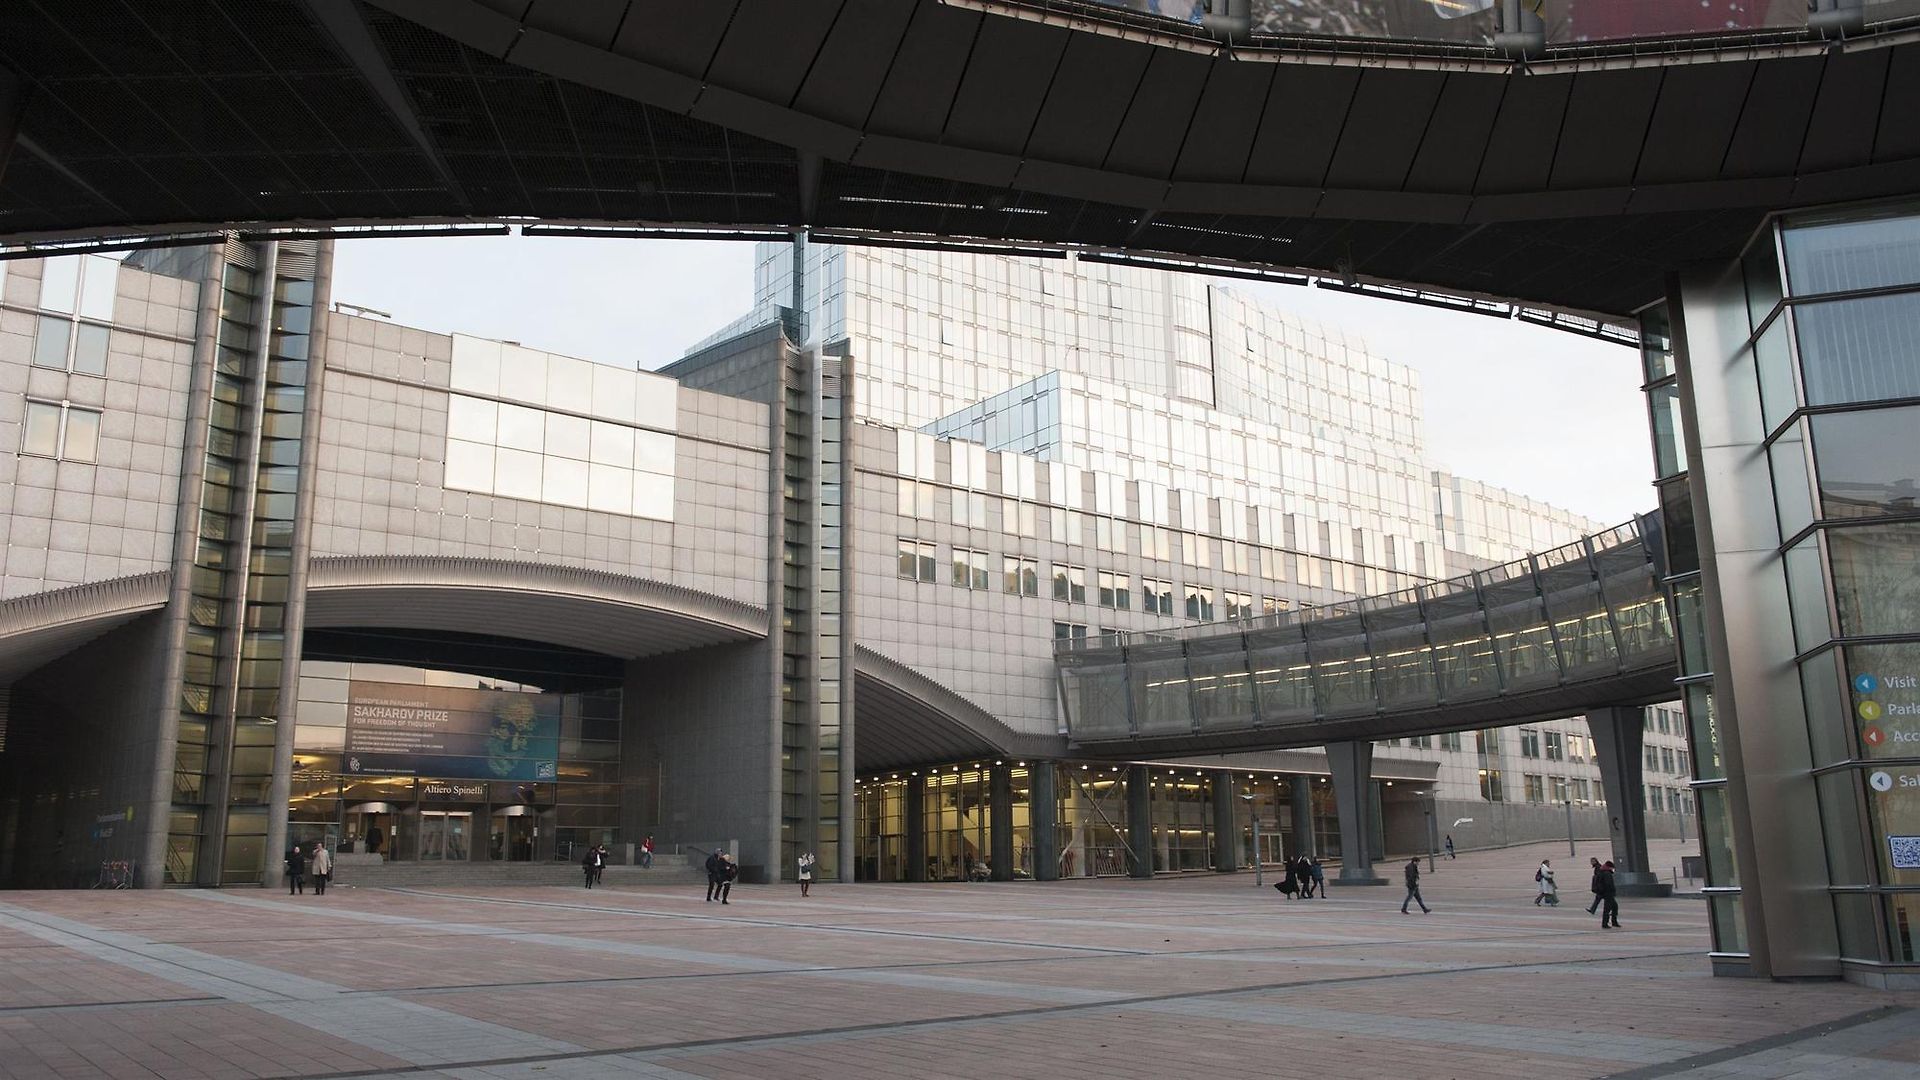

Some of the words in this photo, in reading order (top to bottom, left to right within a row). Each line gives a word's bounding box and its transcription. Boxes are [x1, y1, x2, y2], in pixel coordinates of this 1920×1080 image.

[1884, 675, 1918, 688] Visit
[354, 697, 389, 705] EUROPEAN
[389, 699, 429, 708] PARLIAMENT
[354, 706, 415, 720] SAKHAROV
[416, 710, 449, 721] PRIZE
[367, 718, 397, 726] FREEDOM
[423, 785, 452, 794] Altiero
[453, 785, 483, 796] Spinelli
